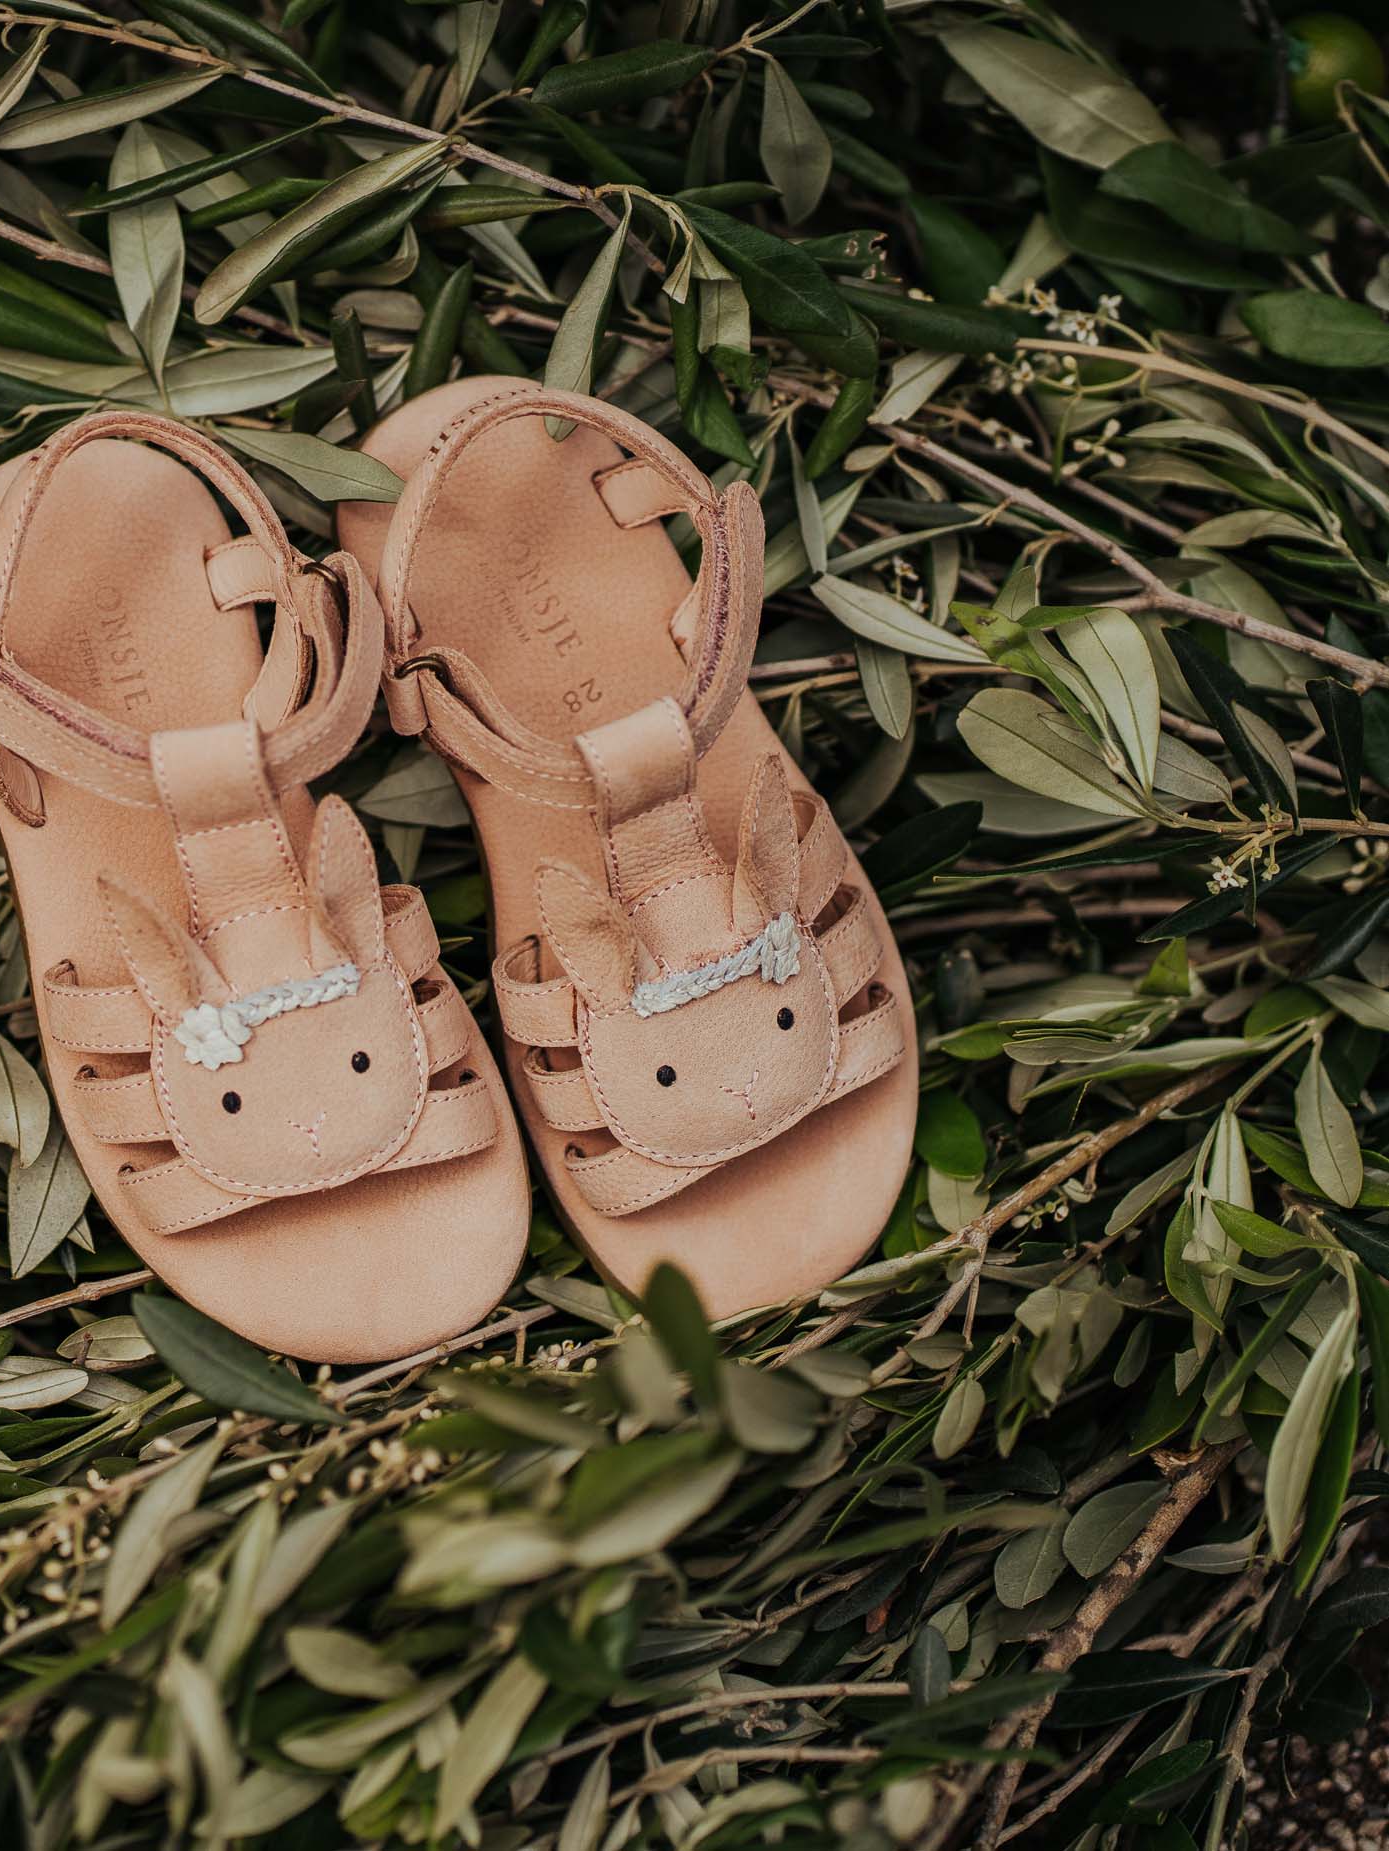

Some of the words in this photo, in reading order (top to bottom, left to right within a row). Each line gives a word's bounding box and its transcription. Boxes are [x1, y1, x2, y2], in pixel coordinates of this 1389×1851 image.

[94, 574, 152, 711] ONSJE
[505, 531, 583, 658] ONSJE
[562, 677, 603, 714] 28
